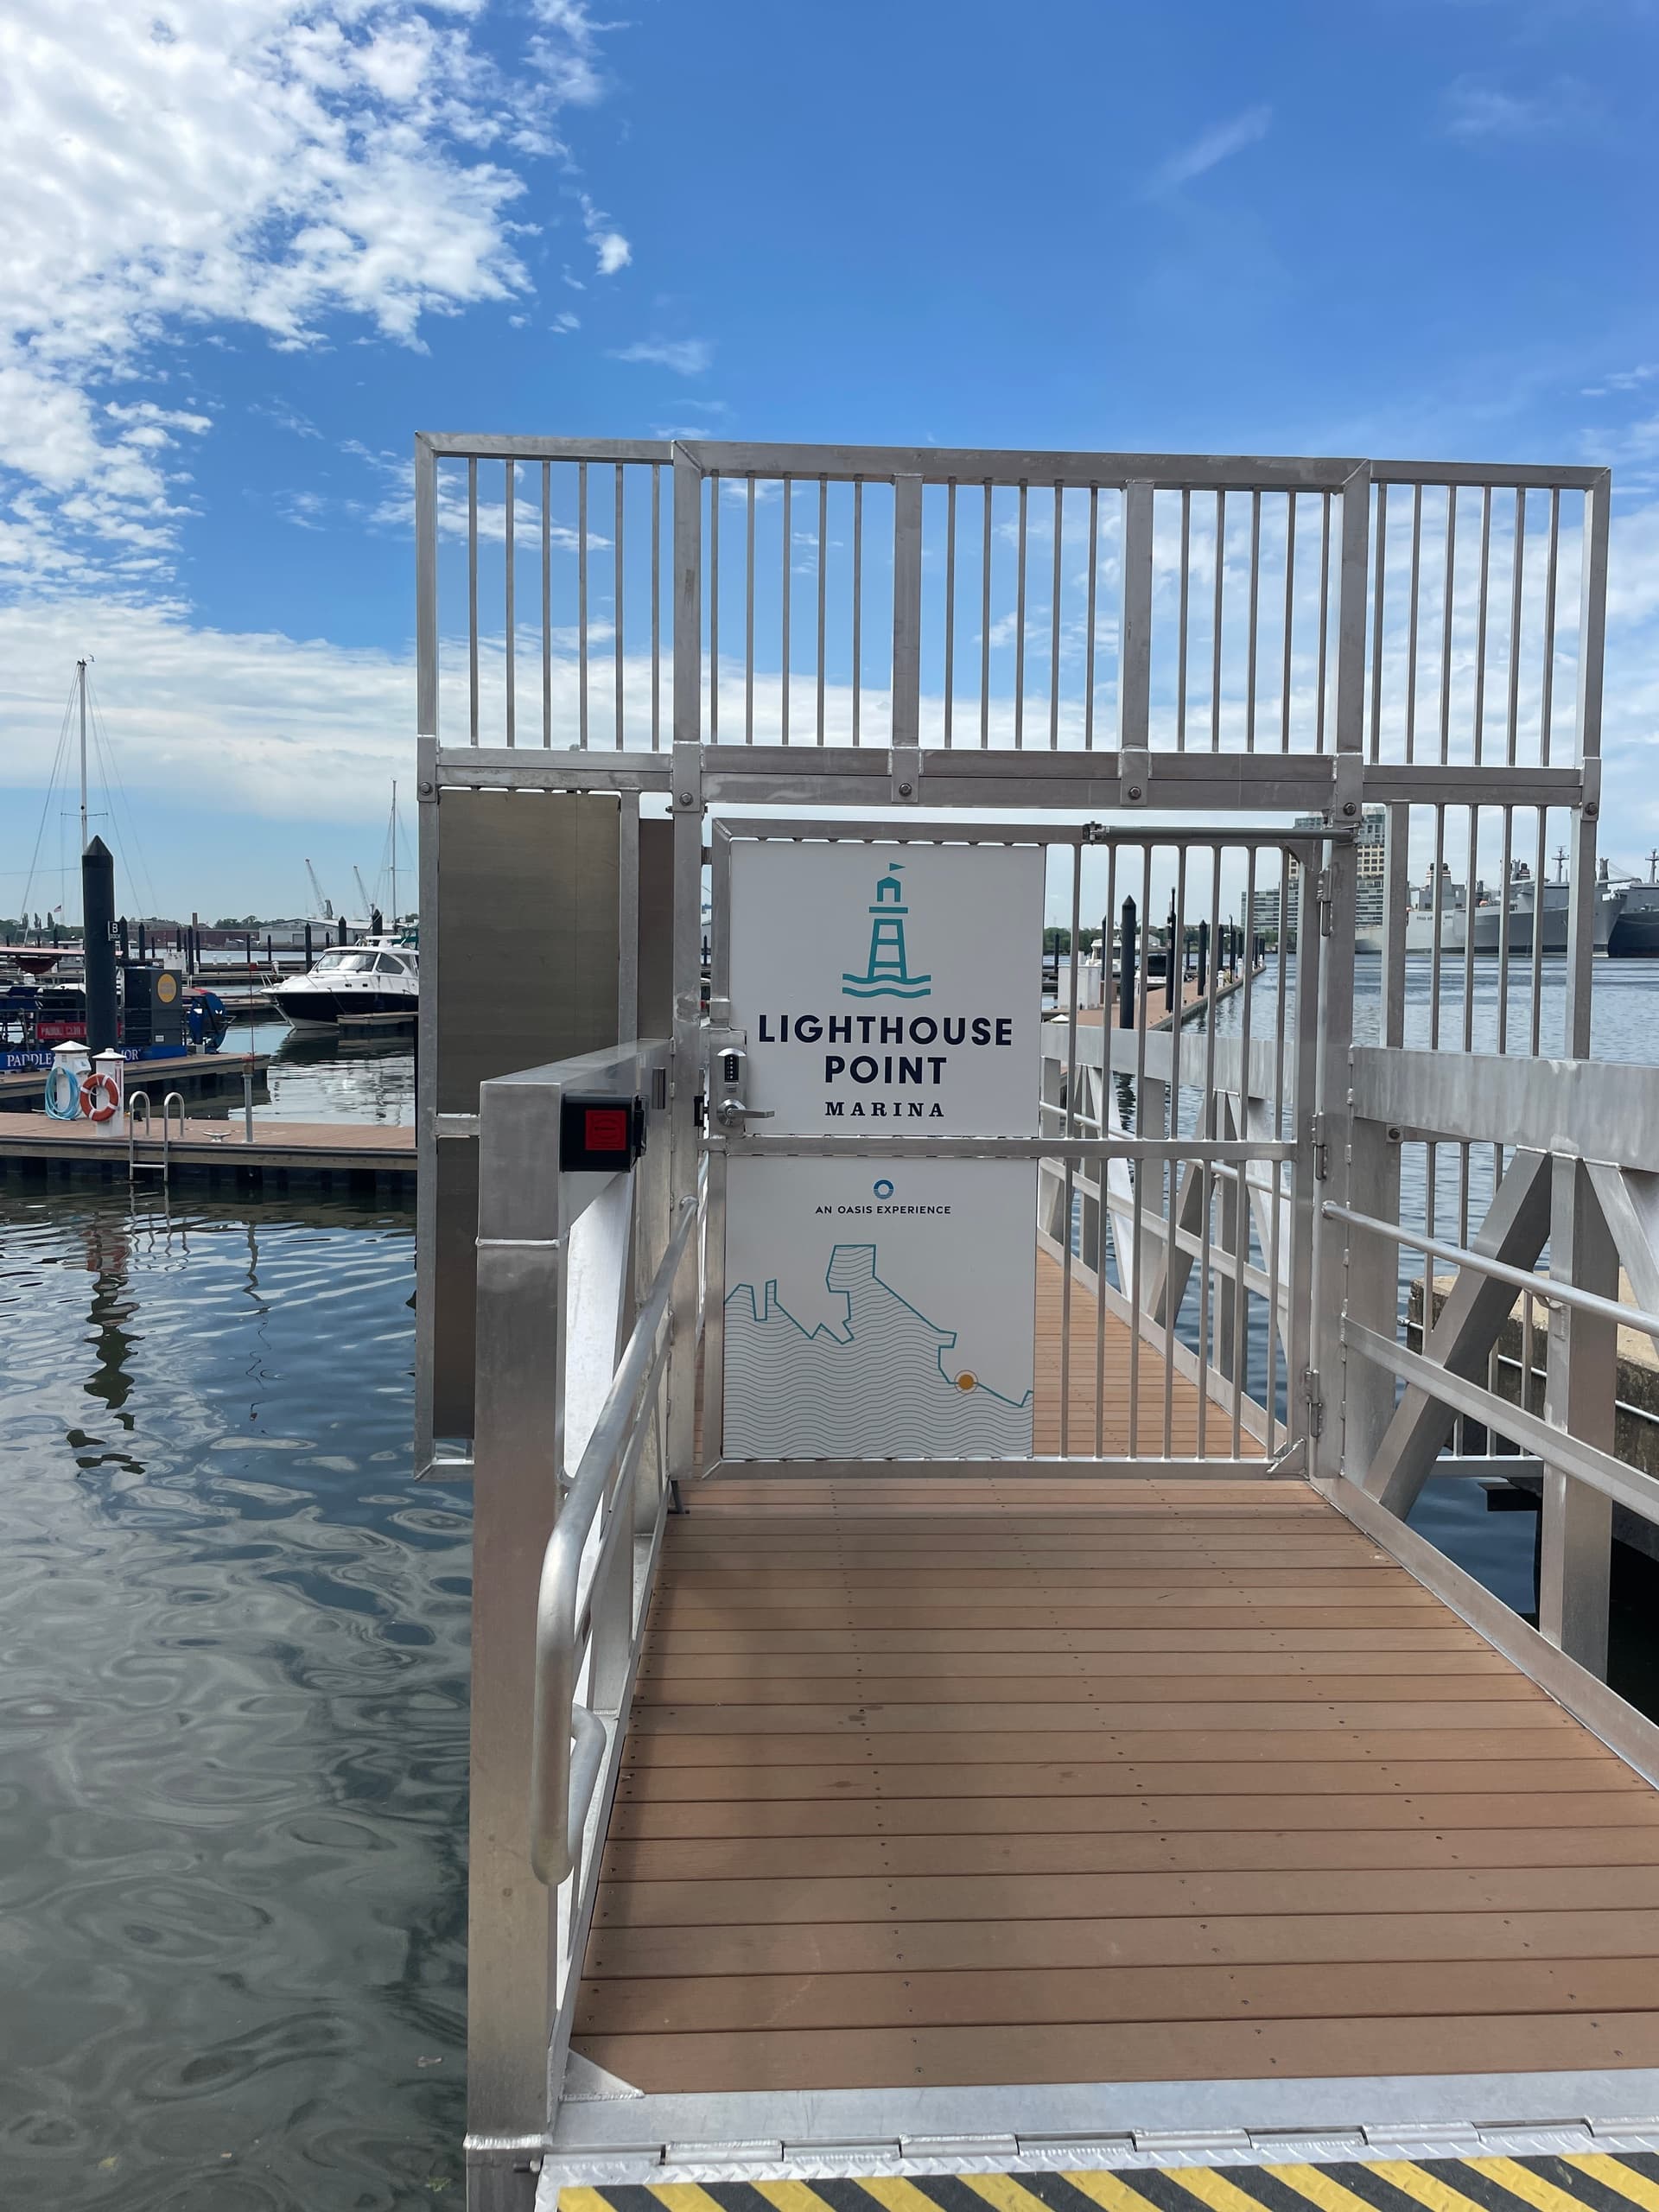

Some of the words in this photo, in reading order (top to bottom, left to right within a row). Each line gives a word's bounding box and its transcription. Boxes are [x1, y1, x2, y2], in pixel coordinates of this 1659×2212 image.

[112, 923, 118, 933] B
[759, 1014, 1013, 1046] LIGHTHOUSE
[7, 1052, 52, 1067] PADDLE
[824, 1055, 948, 1084] POINT
[824, 1102, 944, 1117] MARINA
[815, 1205, 832, 1214] AN
[837, 1205, 873, 1214] OASIS
[876, 1205, 951, 1214] EXPERIENCE
